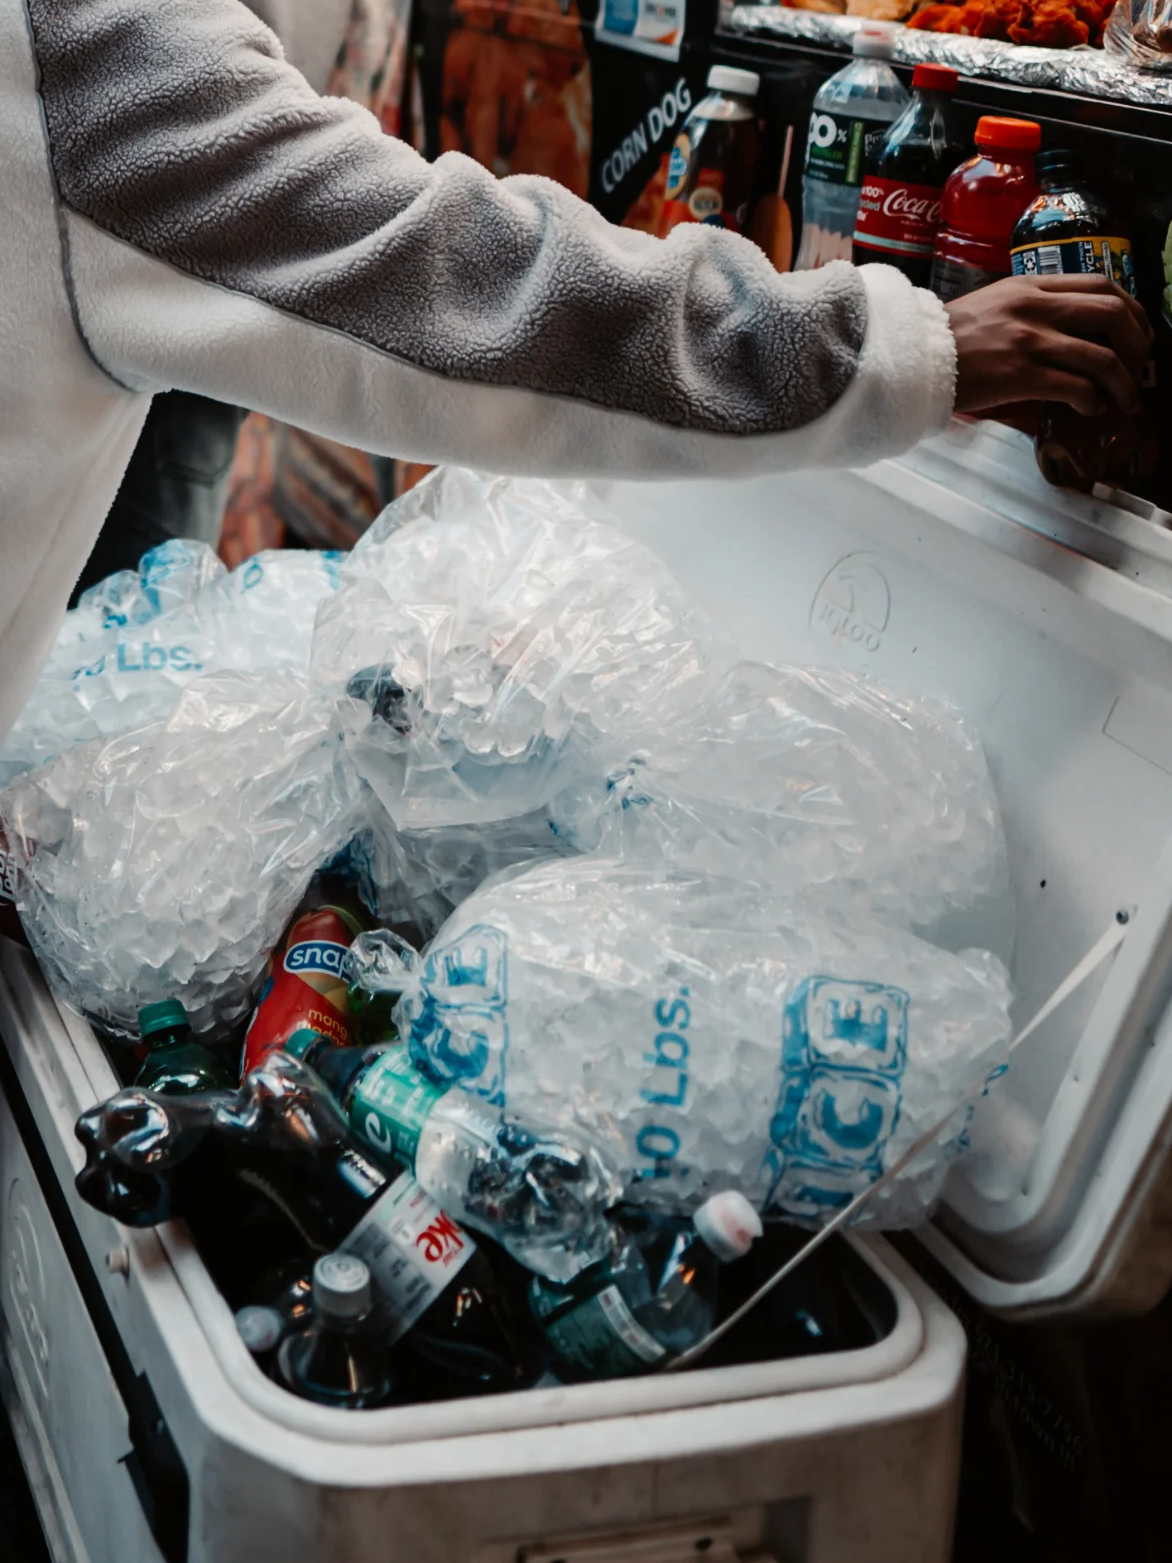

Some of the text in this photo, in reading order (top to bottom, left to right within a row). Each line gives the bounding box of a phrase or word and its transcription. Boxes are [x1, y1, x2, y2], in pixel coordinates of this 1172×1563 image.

[602, 122, 648, 193] CORN
[647, 77, 692, 144] DOG
[117, 642, 203, 672] Lbs.
[640, 986, 691, 1107] Lbs.
[790, 994, 892, 1212] ICE
